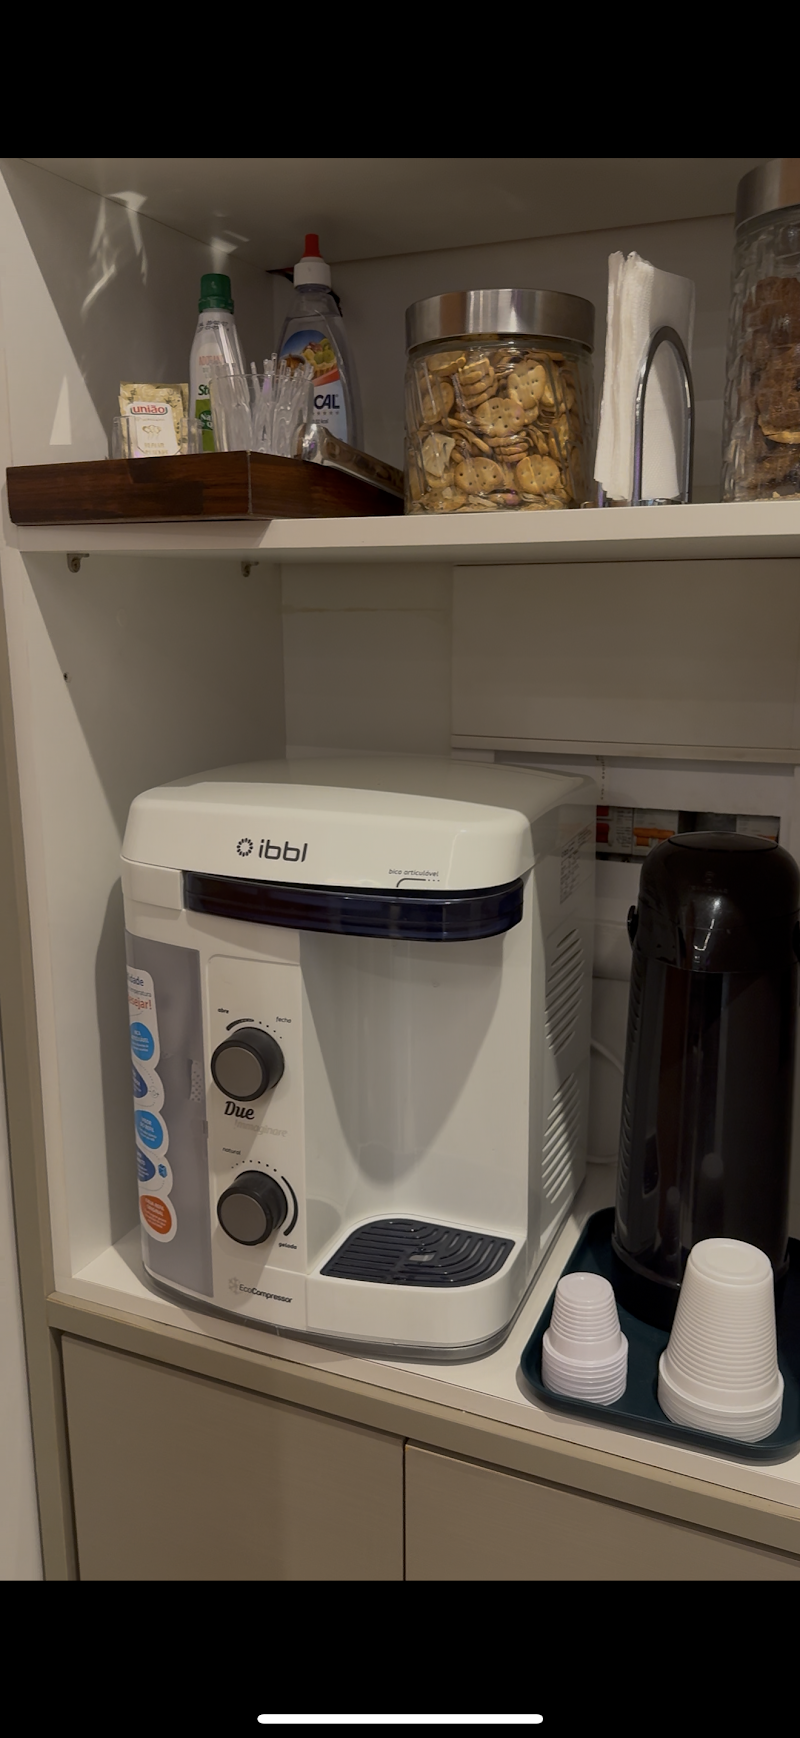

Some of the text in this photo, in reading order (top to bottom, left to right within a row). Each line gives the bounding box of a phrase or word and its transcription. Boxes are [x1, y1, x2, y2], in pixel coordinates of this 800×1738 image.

[132, 404, 166, 414] união
[258, 838, 308, 863] ibbl
[224, 1100, 255, 1120] Due
[239, 1283, 293, 1303] EcoCompressor
